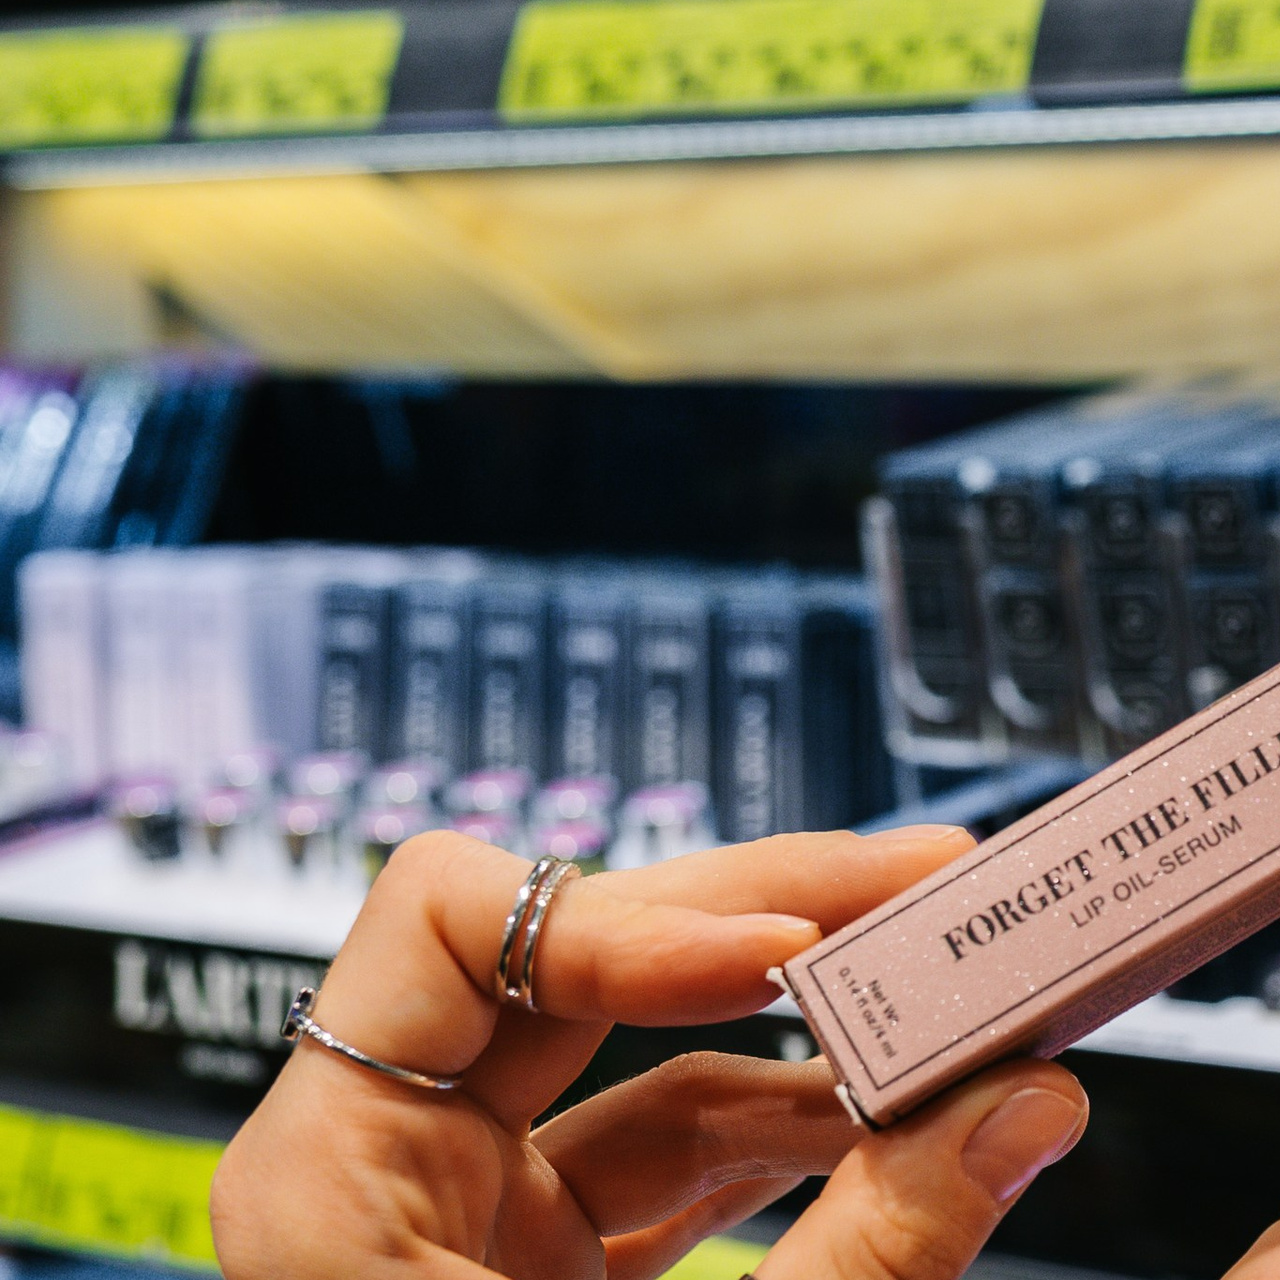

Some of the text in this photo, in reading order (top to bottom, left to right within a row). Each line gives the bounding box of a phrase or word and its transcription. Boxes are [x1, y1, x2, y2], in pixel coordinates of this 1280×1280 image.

[941, 851, 1094, 962] FORGET
[1102, 796, 1191, 861] THE
[1069, 814, 1245, 929] LIP OIL-SERUM
[113, 940, 320, 1050] L'ART
